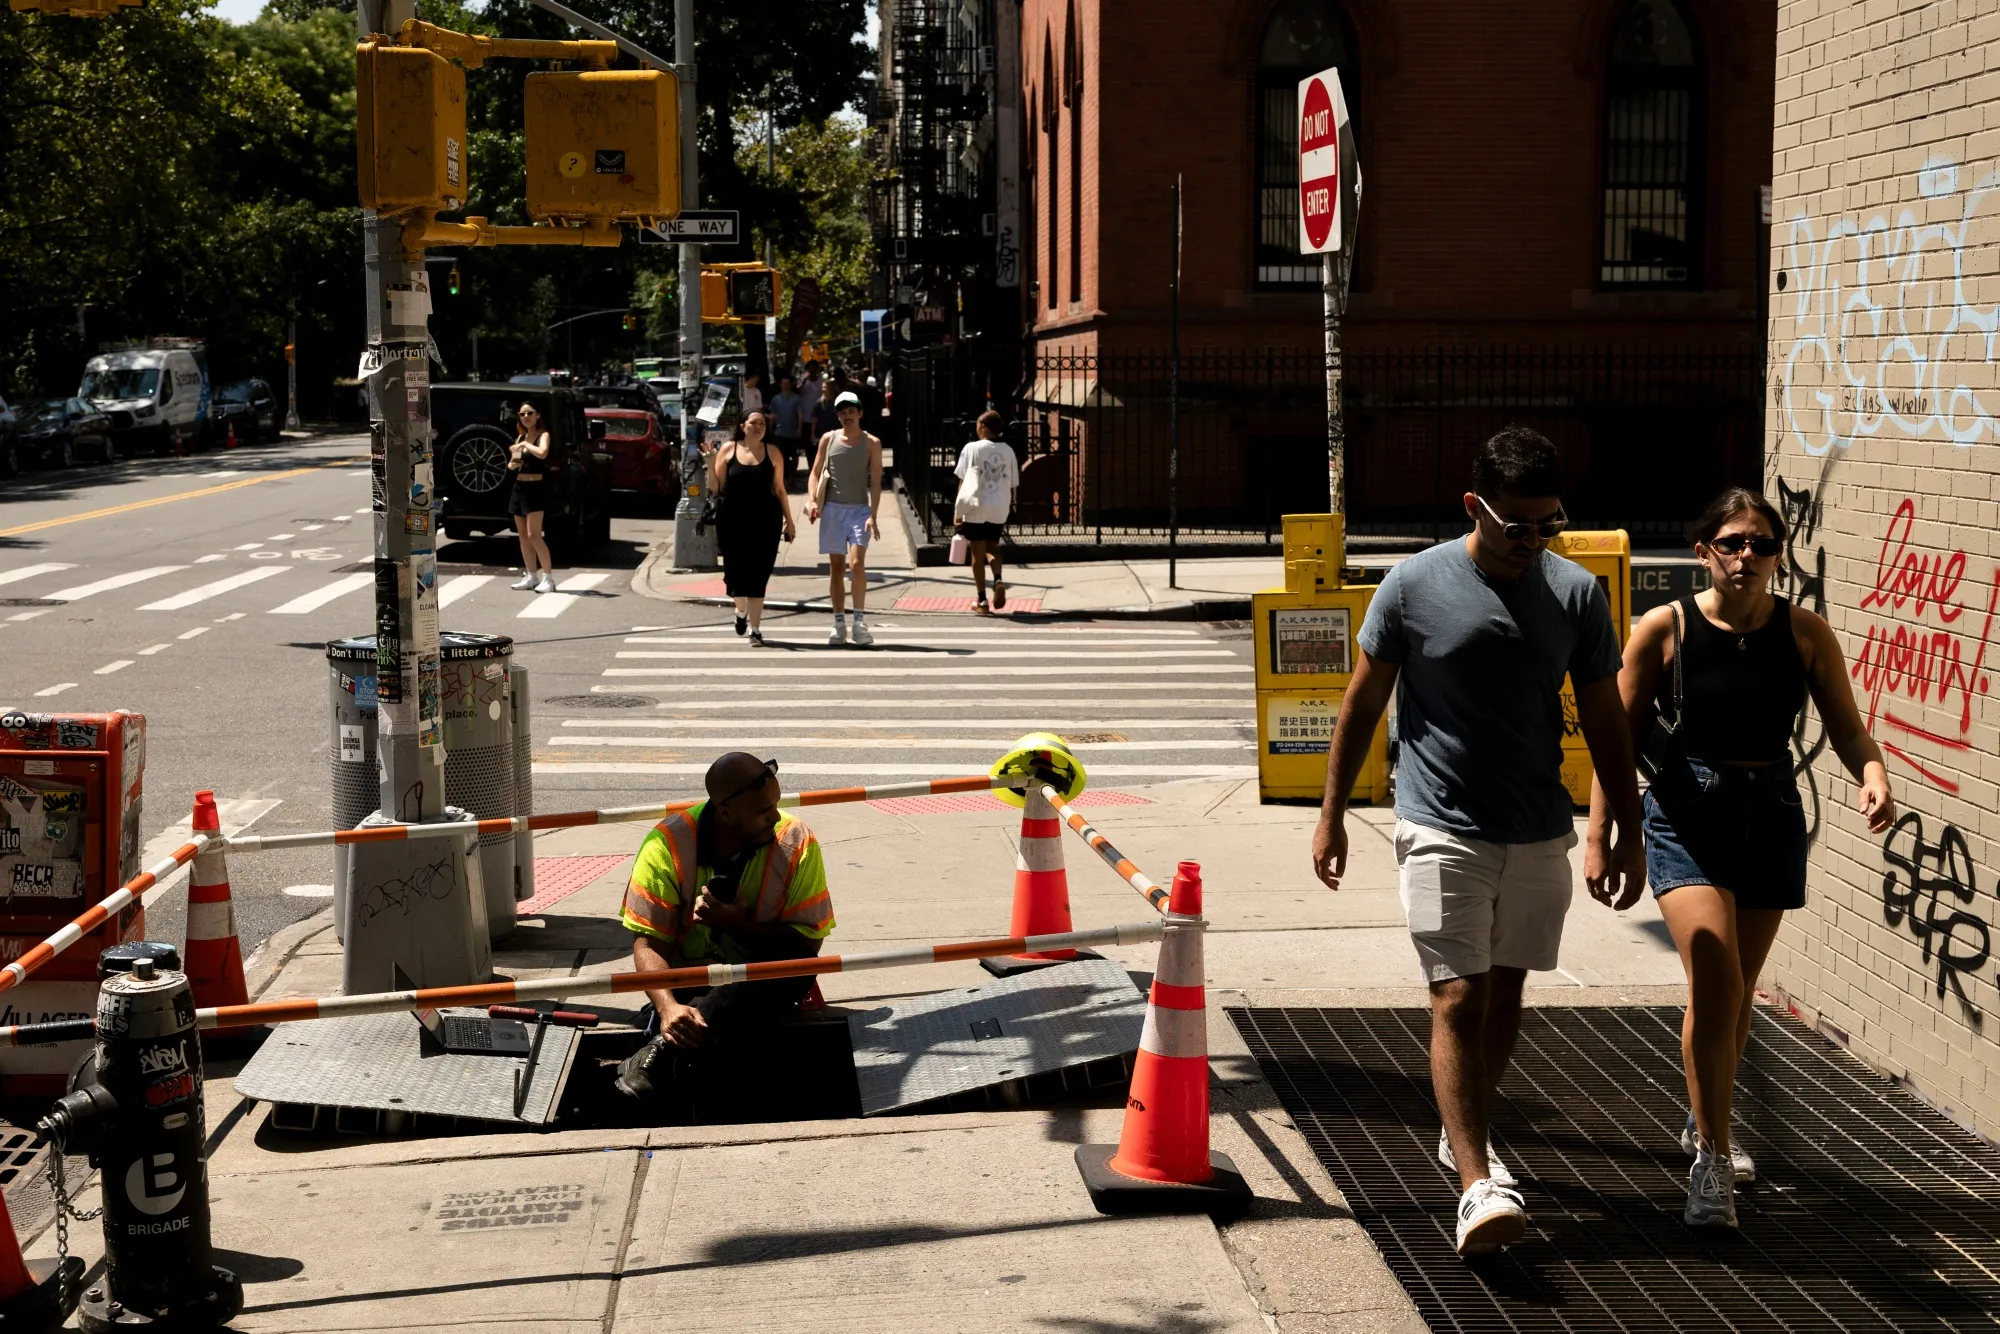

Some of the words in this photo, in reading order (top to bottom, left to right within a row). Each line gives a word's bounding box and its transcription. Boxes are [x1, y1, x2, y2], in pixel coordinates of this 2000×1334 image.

[1304, 115, 1313, 141] DO
[1315, 109, 1329, 138] NOT
[1306, 187, 1330, 217] ENTER
[659, 220, 686, 234] ONE
[698, 220, 728, 234] WAY
[917, 308, 942, 320] ATM
[1860, 498, 1967, 624] love
[1630, 570, 1671, 591] ICE
[331, 646, 352, 659] Don't
[355, 649, 377, 660] litte
[451, 648, 480, 658] litter
[360, 710, 378, 720] Put
[445, 709, 478, 721] place.
[1280, 716, 1338, 726] 歷史巨變在眼
[1280, 727, 1334, 737] 指路真相大
[525, 1191, 581, 1202] LOVE
[435, 1200, 583, 1220] KAIYOTE
[127, 1216, 190, 1236] BRIGADE
[440, 1212, 569, 1231] HIATUS
